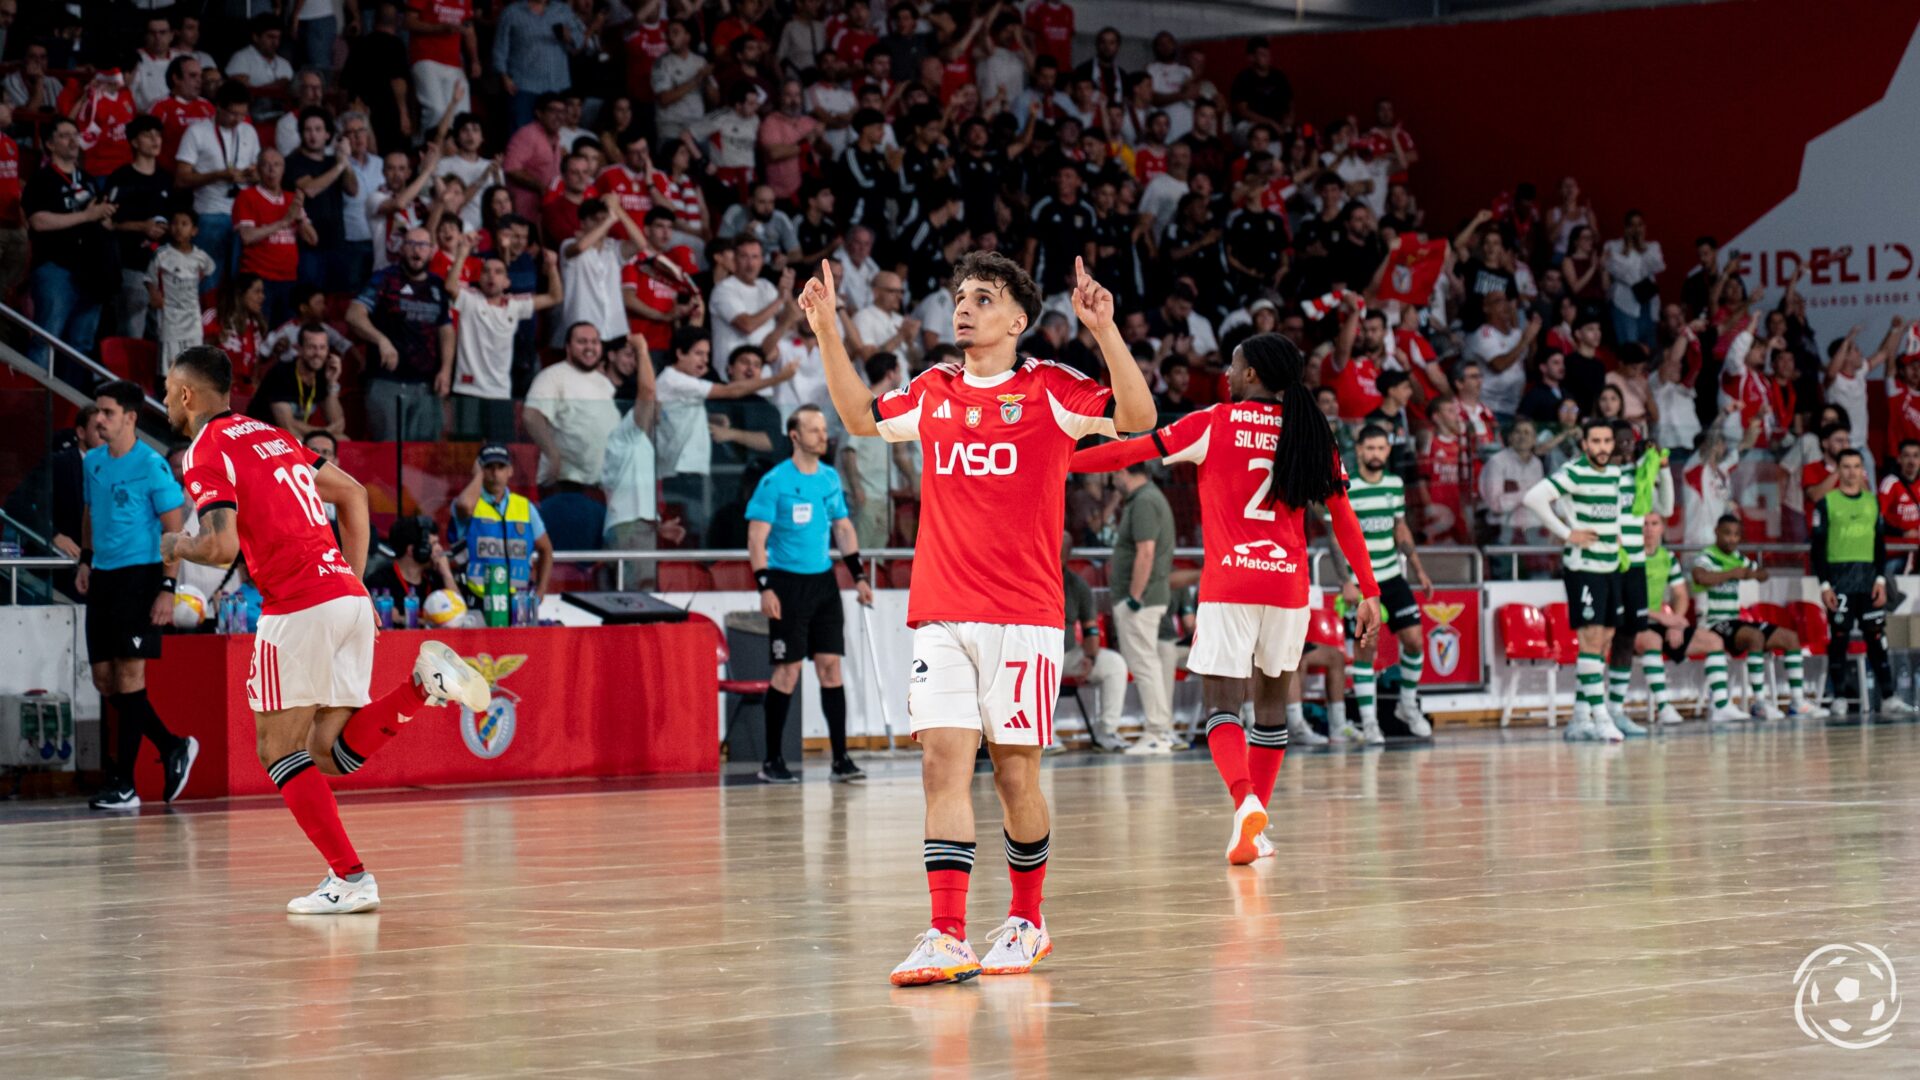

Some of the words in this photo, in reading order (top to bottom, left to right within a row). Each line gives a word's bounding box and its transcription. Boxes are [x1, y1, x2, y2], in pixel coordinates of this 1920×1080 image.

[1738, 243, 1920, 287] FIDELID
[934, 440, 1018, 476] LASO
[1235, 430, 1280, 451] SILVES
[273, 463, 328, 527] 18
[1243, 457, 1276, 522] 2
[1236, 556, 1298, 573] MatosCar
[1005, 661, 1028, 703] 7
